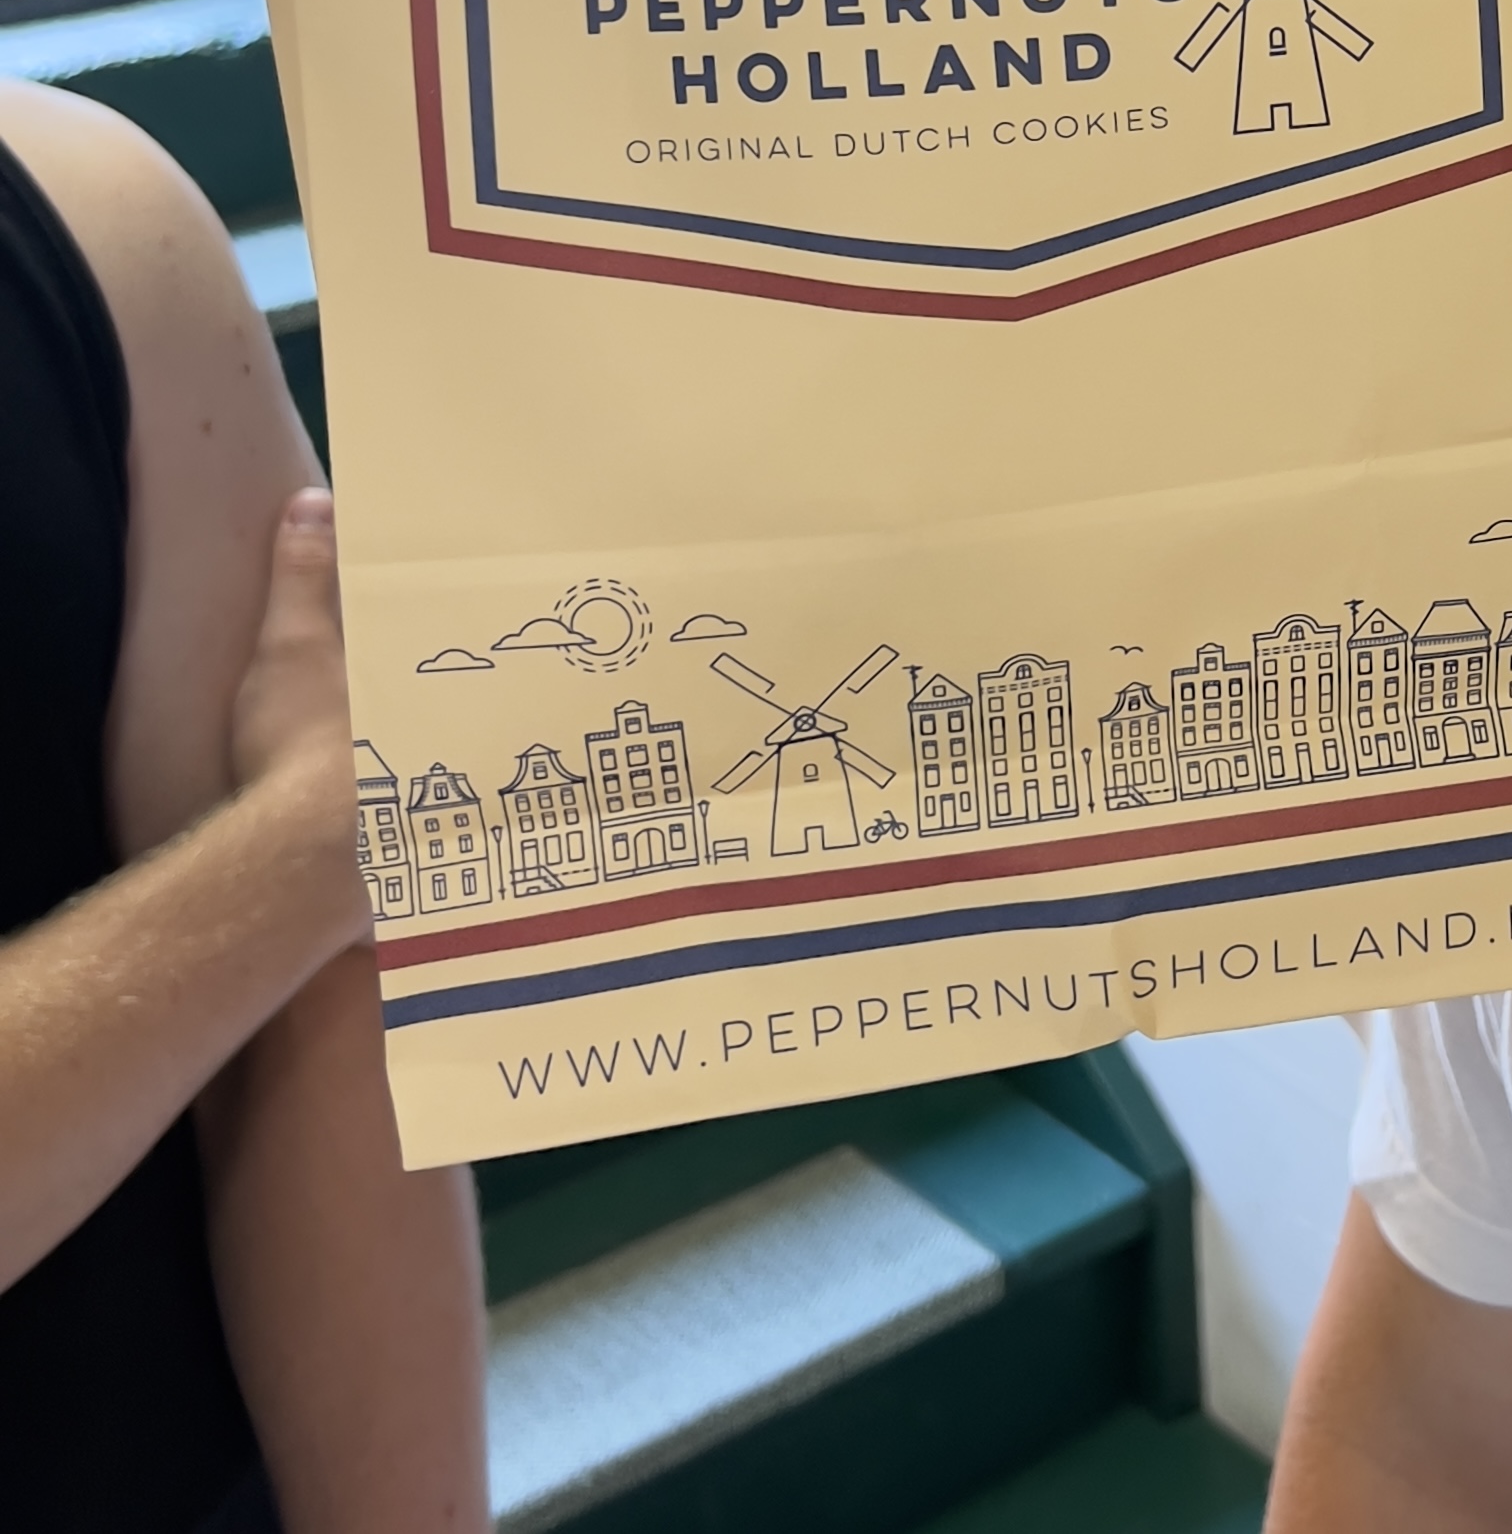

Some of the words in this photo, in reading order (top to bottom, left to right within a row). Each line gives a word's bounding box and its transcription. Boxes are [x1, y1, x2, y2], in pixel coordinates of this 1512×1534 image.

[671, 32, 1112, 104] HOLLAND
[625, 132, 815, 164] ORIGINAL
[834, 124, 970, 158] DUTCH
[992, 105, 1169, 145] COOKIES
